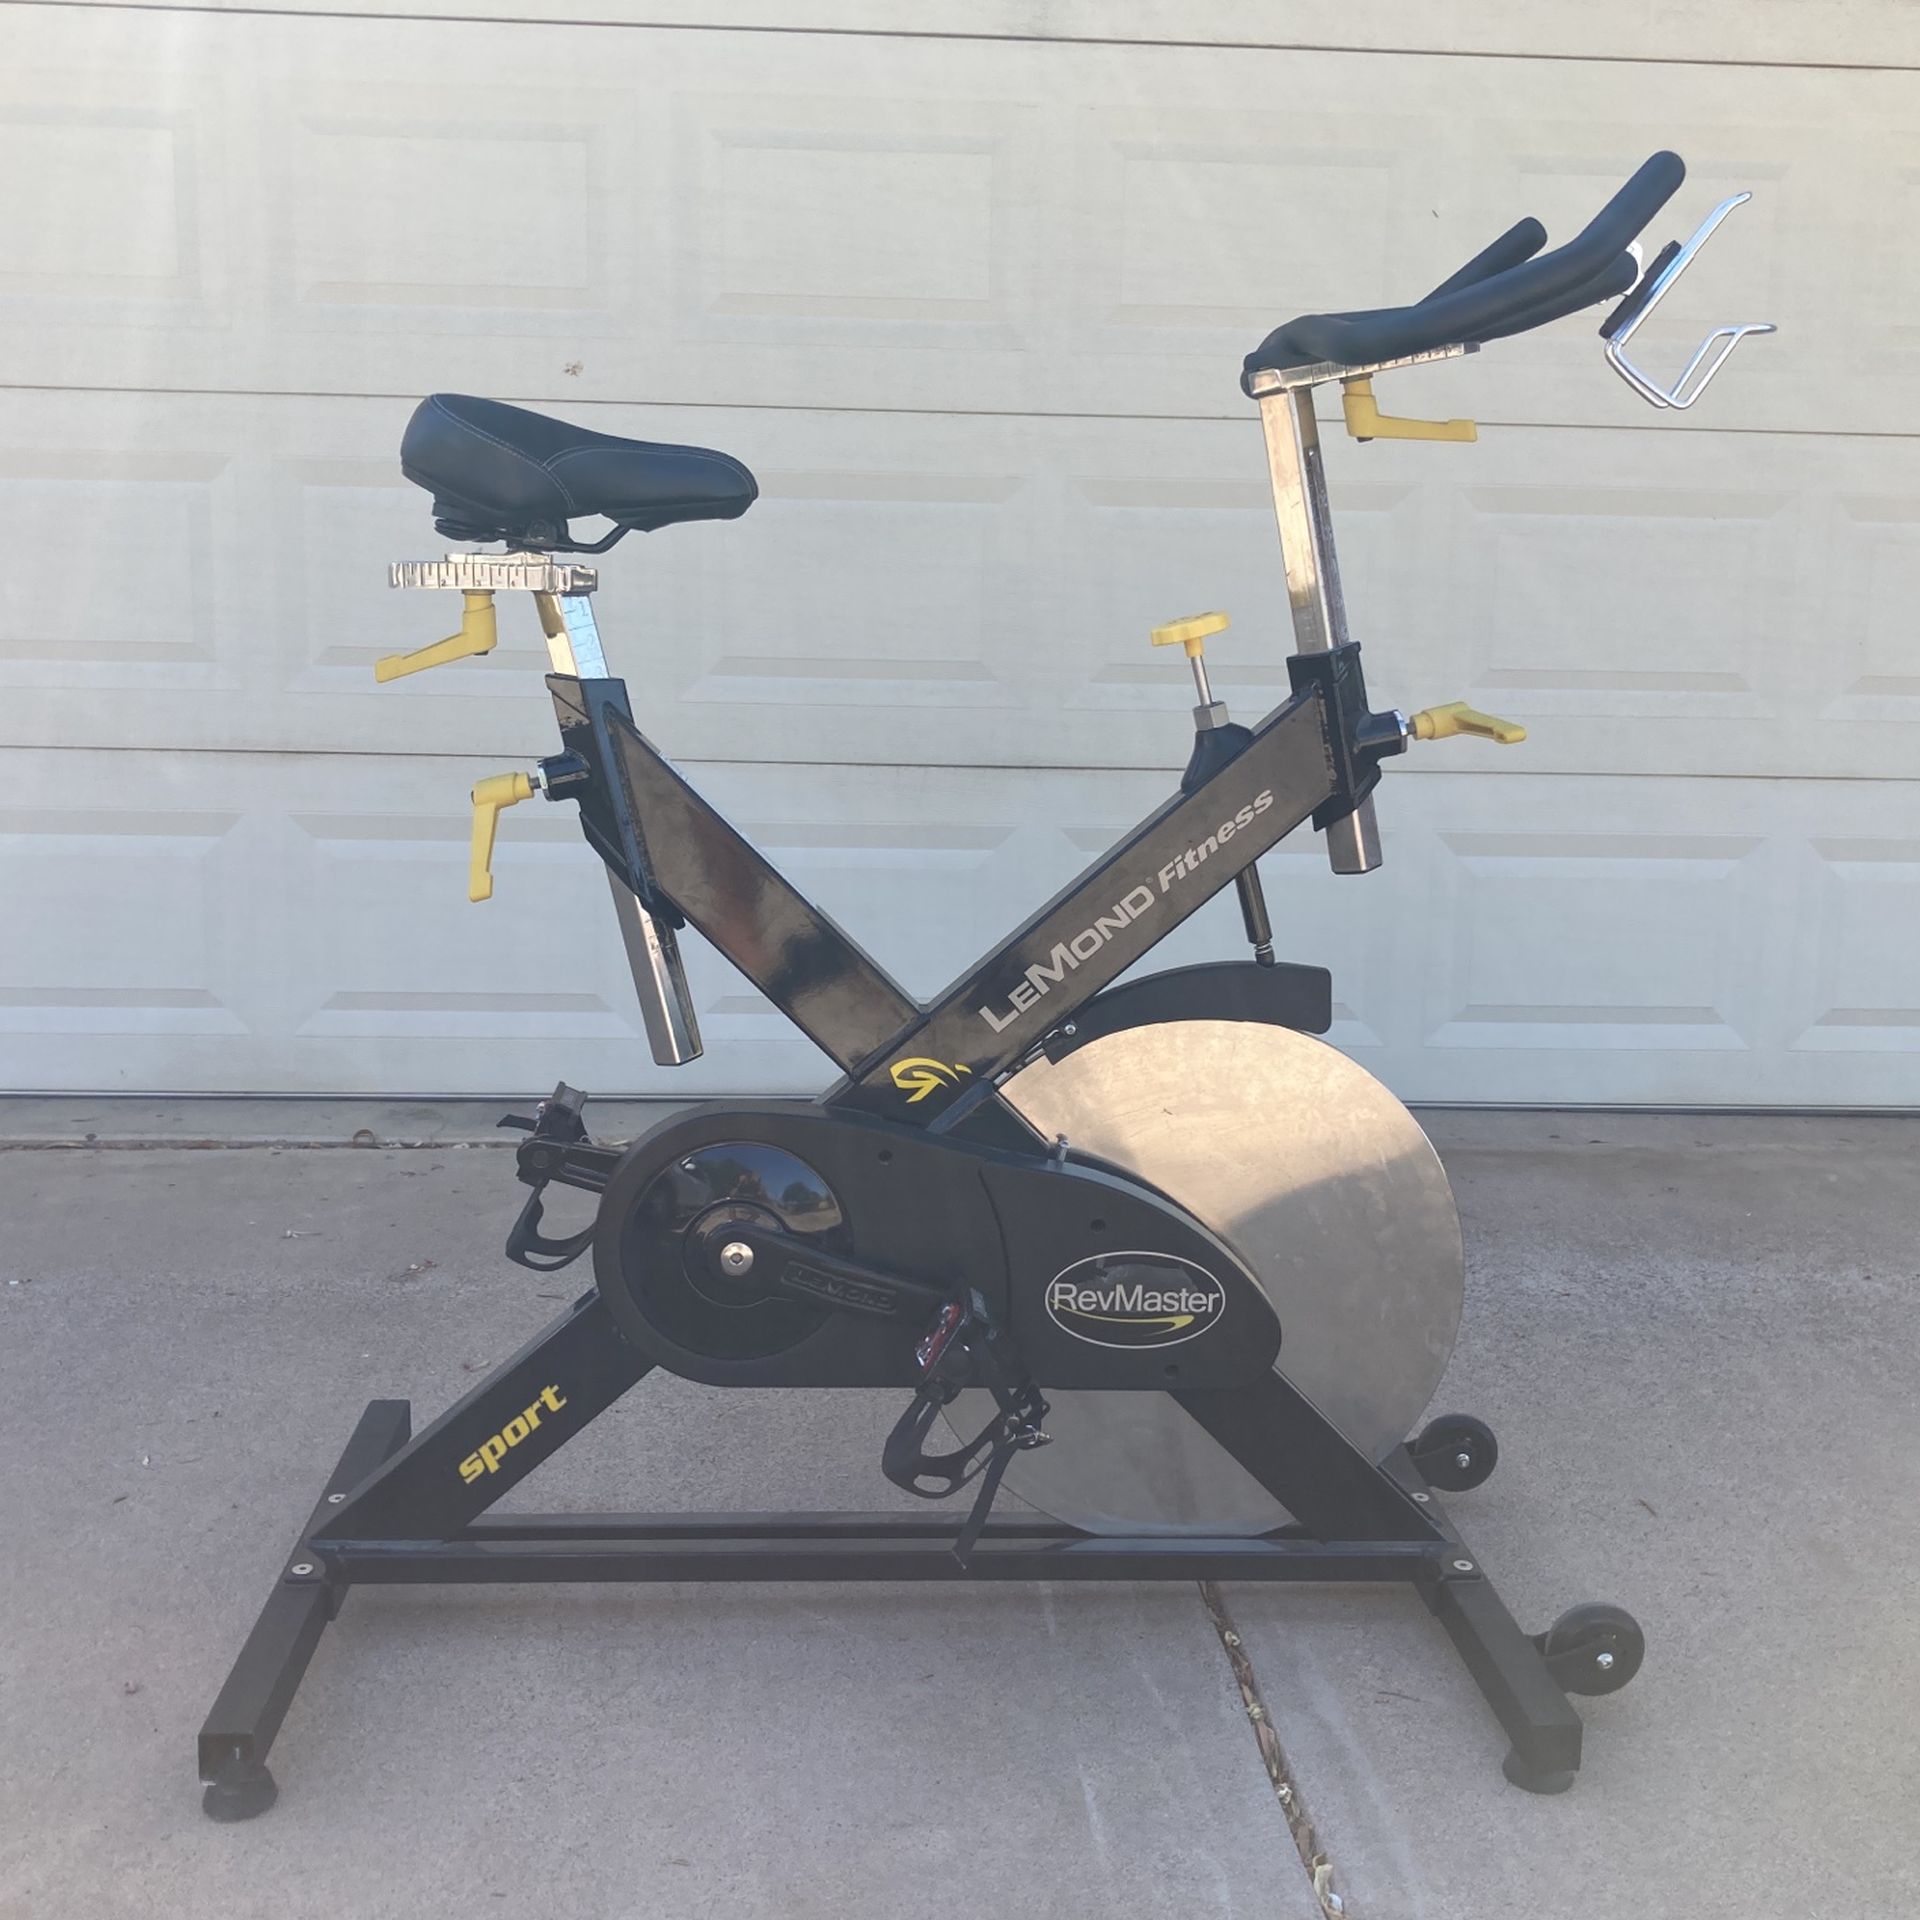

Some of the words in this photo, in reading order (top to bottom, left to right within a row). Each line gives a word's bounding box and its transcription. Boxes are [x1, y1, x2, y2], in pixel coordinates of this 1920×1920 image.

[1157, 789, 1274, 893] Fitness
[1053, 1282, 1221, 1313] RevMaster
[458, 1384, 568, 1485] sport
